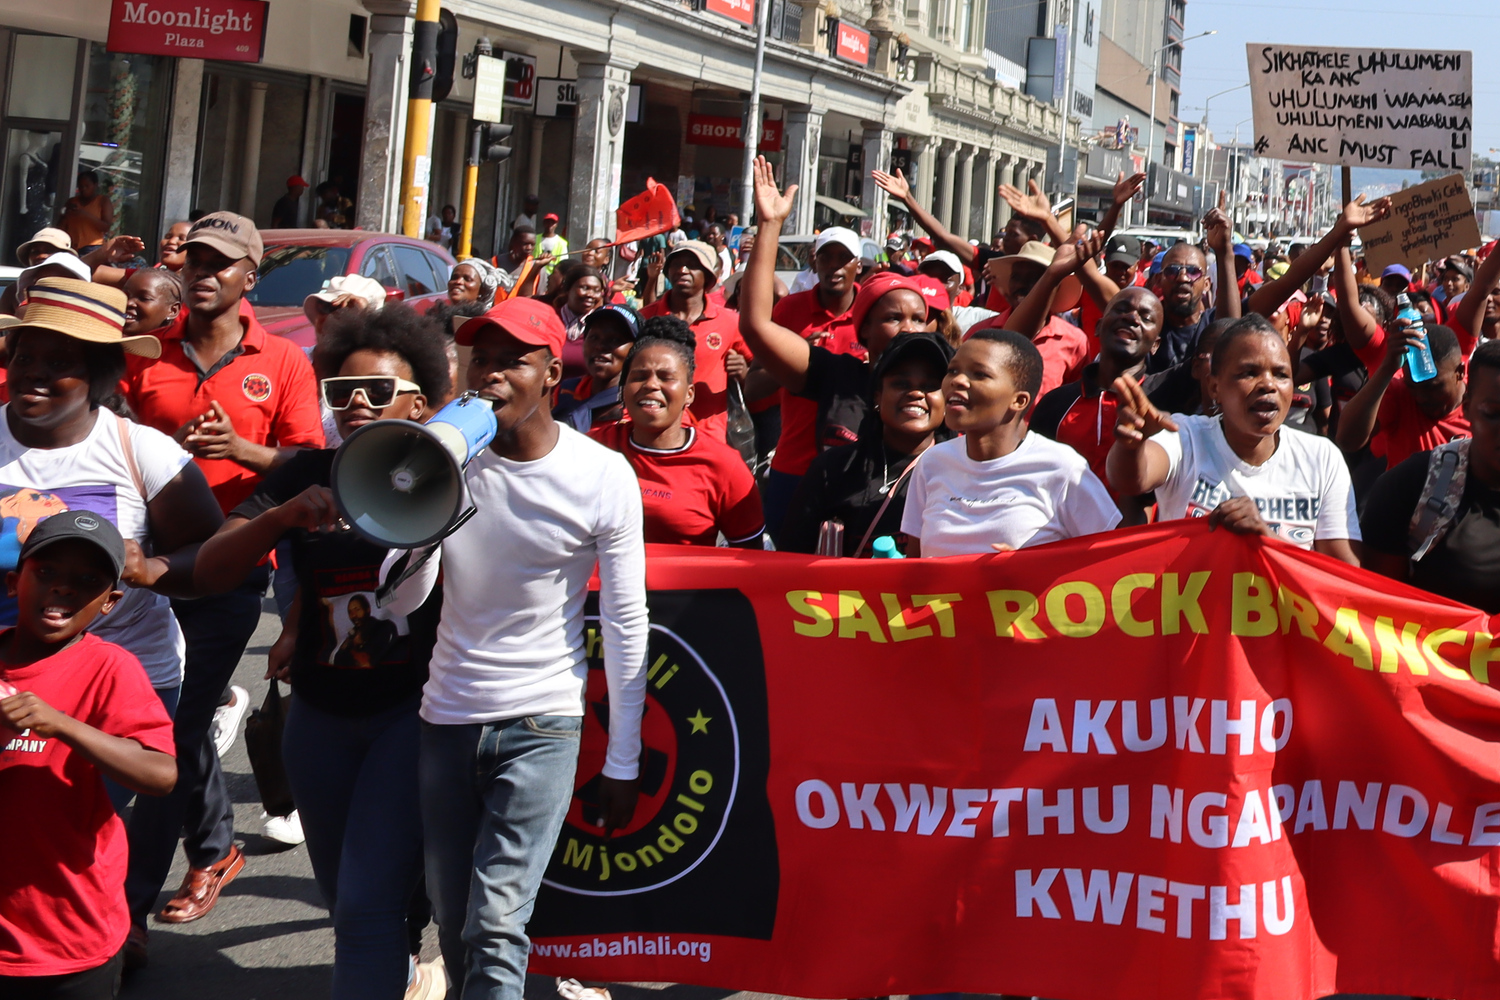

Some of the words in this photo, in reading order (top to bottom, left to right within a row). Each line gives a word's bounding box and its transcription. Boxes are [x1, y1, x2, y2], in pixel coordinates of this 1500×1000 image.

[122, 2, 252, 34] Moonlight
[164, 33, 204, 48] Plaza
[1262, 47, 1350, 73] SIKHATHELE
[1358, 51, 1461, 74] UHULUMENI
[1301, 70, 1325, 88] KA
[1329, 70, 1363, 87] ANC
[692, 123, 775, 142] SHOPE
[1277, 111, 1383, 131] UHULUMENI
[1288, 133, 1328, 154] ANC
[1339, 138, 1398, 165] MUST
[1410, 149, 1464, 169] FALL
[786, 589, 963, 643] SALT
[986, 571, 1212, 640] ROCK
[1023, 696, 1294, 756] AKUKHO
[5, 738, 47, 753] MPANY
[795, 779, 1130, 838] OKWETHU
[561, 769, 714, 881] Mjondolo
[1015, 868, 1295, 940] KWETHU
